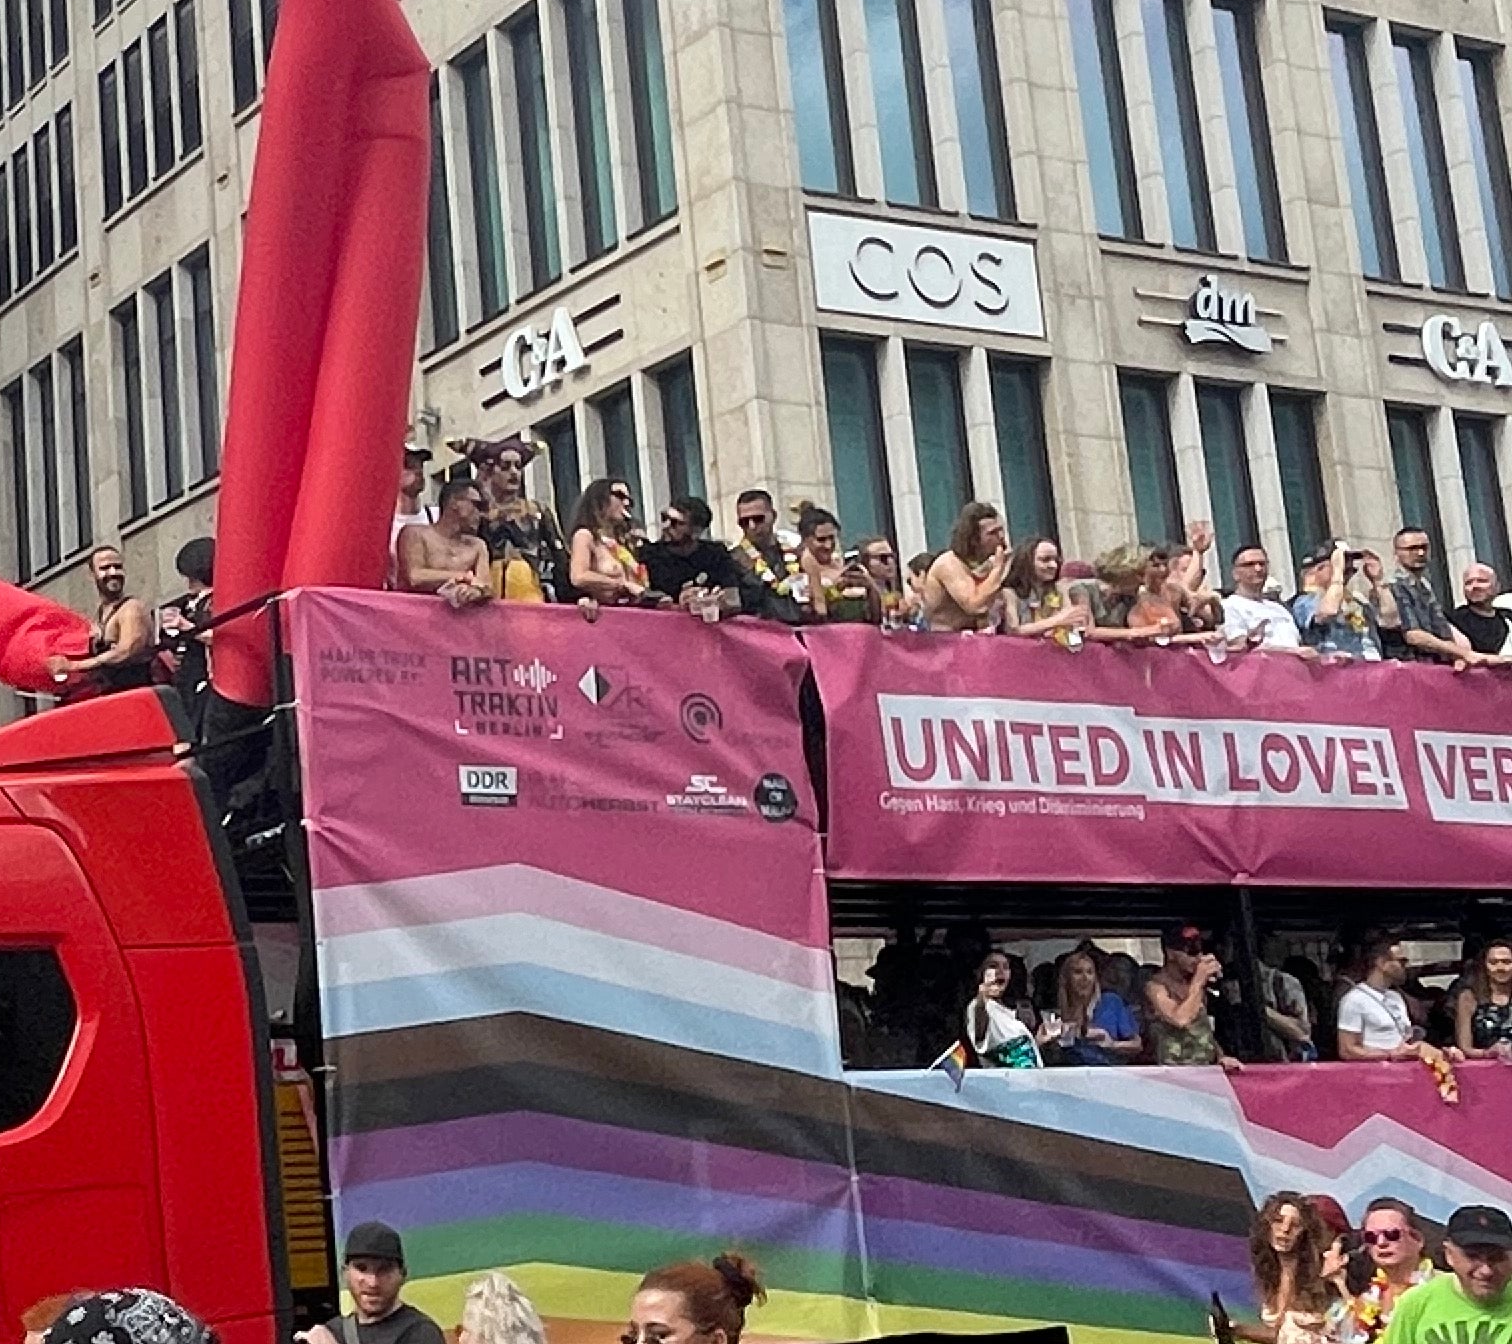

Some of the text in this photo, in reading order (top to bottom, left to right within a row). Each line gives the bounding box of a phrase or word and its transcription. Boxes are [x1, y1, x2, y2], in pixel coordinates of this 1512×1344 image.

[848, 236, 1010, 316] COS
[1194, 274, 1257, 326] dm
[502, 306, 584, 398] C&A
[1422, 315, 1512, 386] C&A
[450, 656, 511, 687] ART
[453, 690, 558, 719] TRAKTIV
[476, 721, 544, 737] BERLIN
[889, 715, 1397, 797] UNITED IN LOVE!
[467, 770, 510, 791] DDR
[966, 796, 1006, 818] Krieg
[1008, 798, 1036, 814] und
